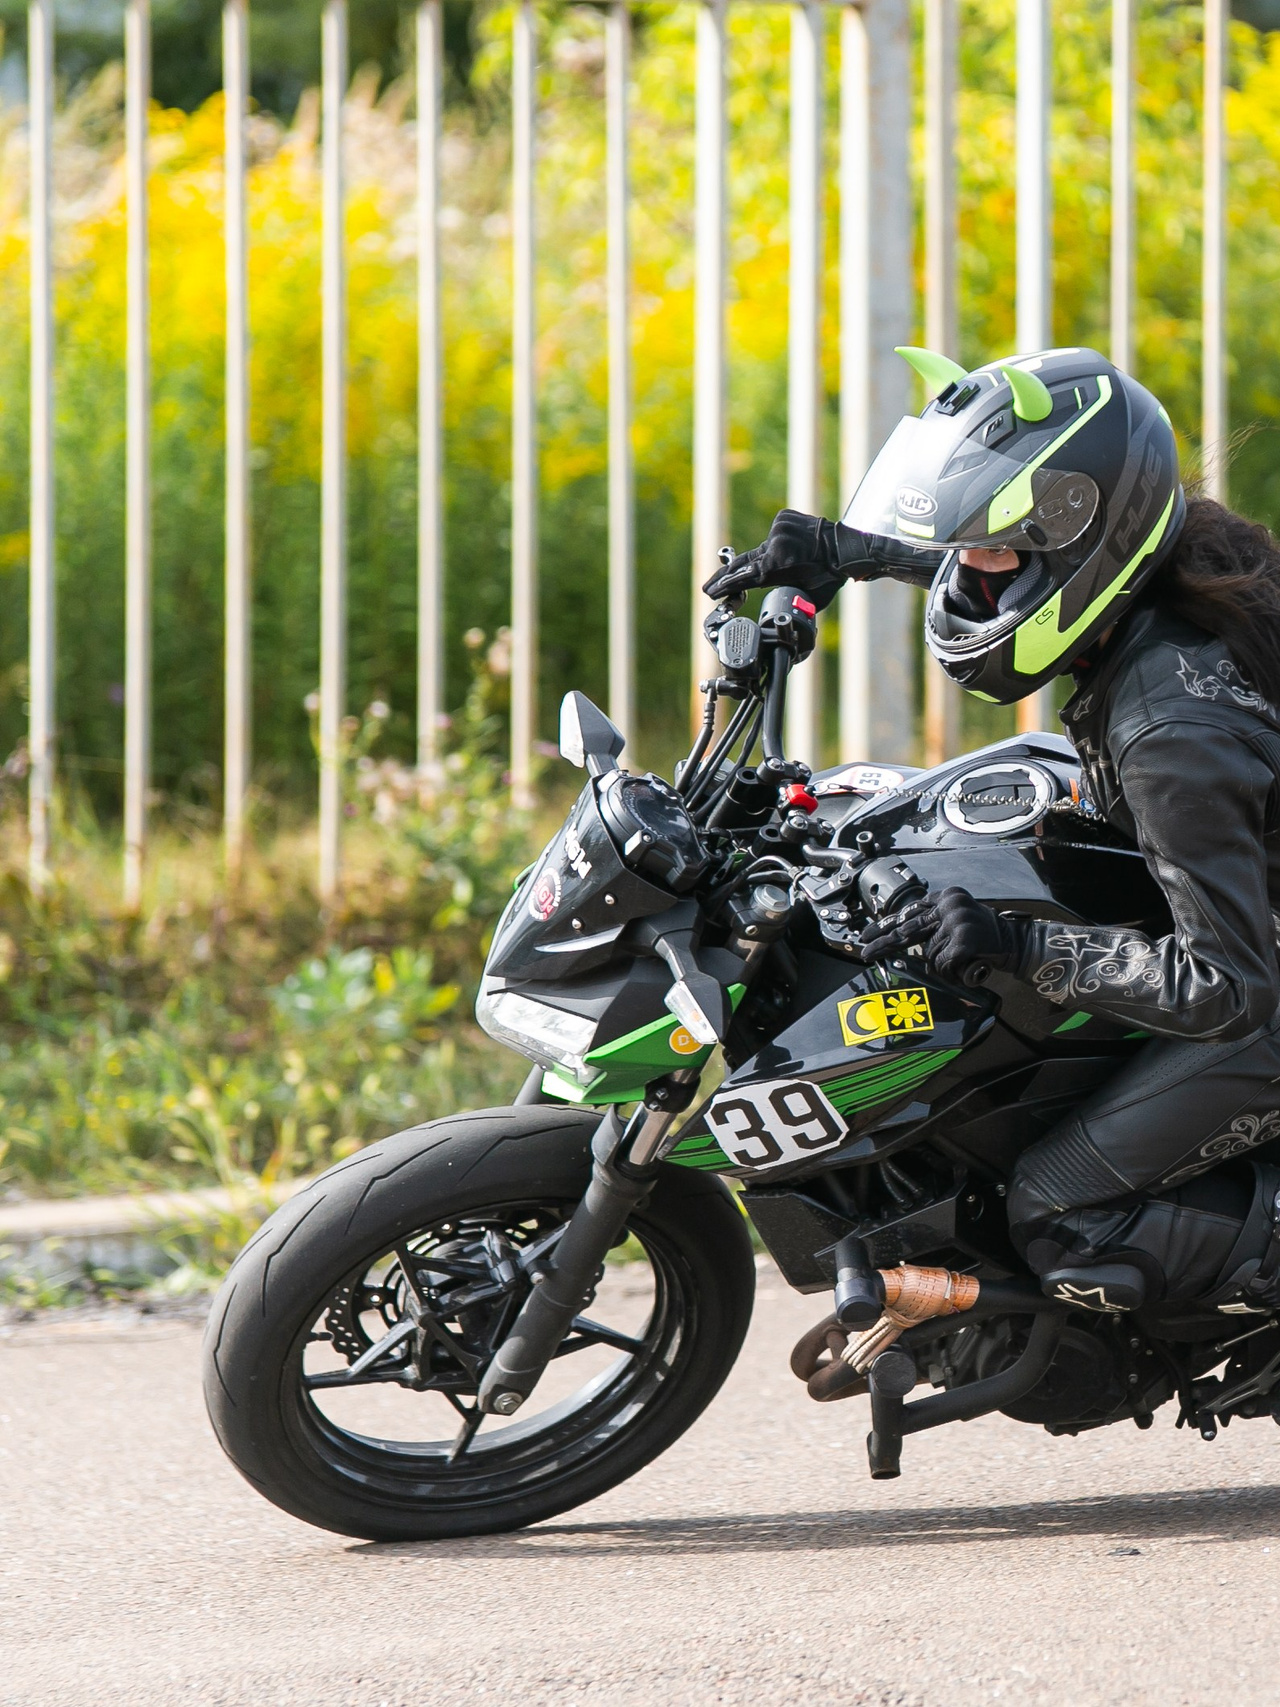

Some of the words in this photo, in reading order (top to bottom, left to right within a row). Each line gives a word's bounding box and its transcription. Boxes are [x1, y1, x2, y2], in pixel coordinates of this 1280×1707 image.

[899, 494, 929, 511] HJC
[1035, 607, 1055, 626] CS
[859, 772, 882, 786] 39
[710, 1081, 844, 1168] 39
